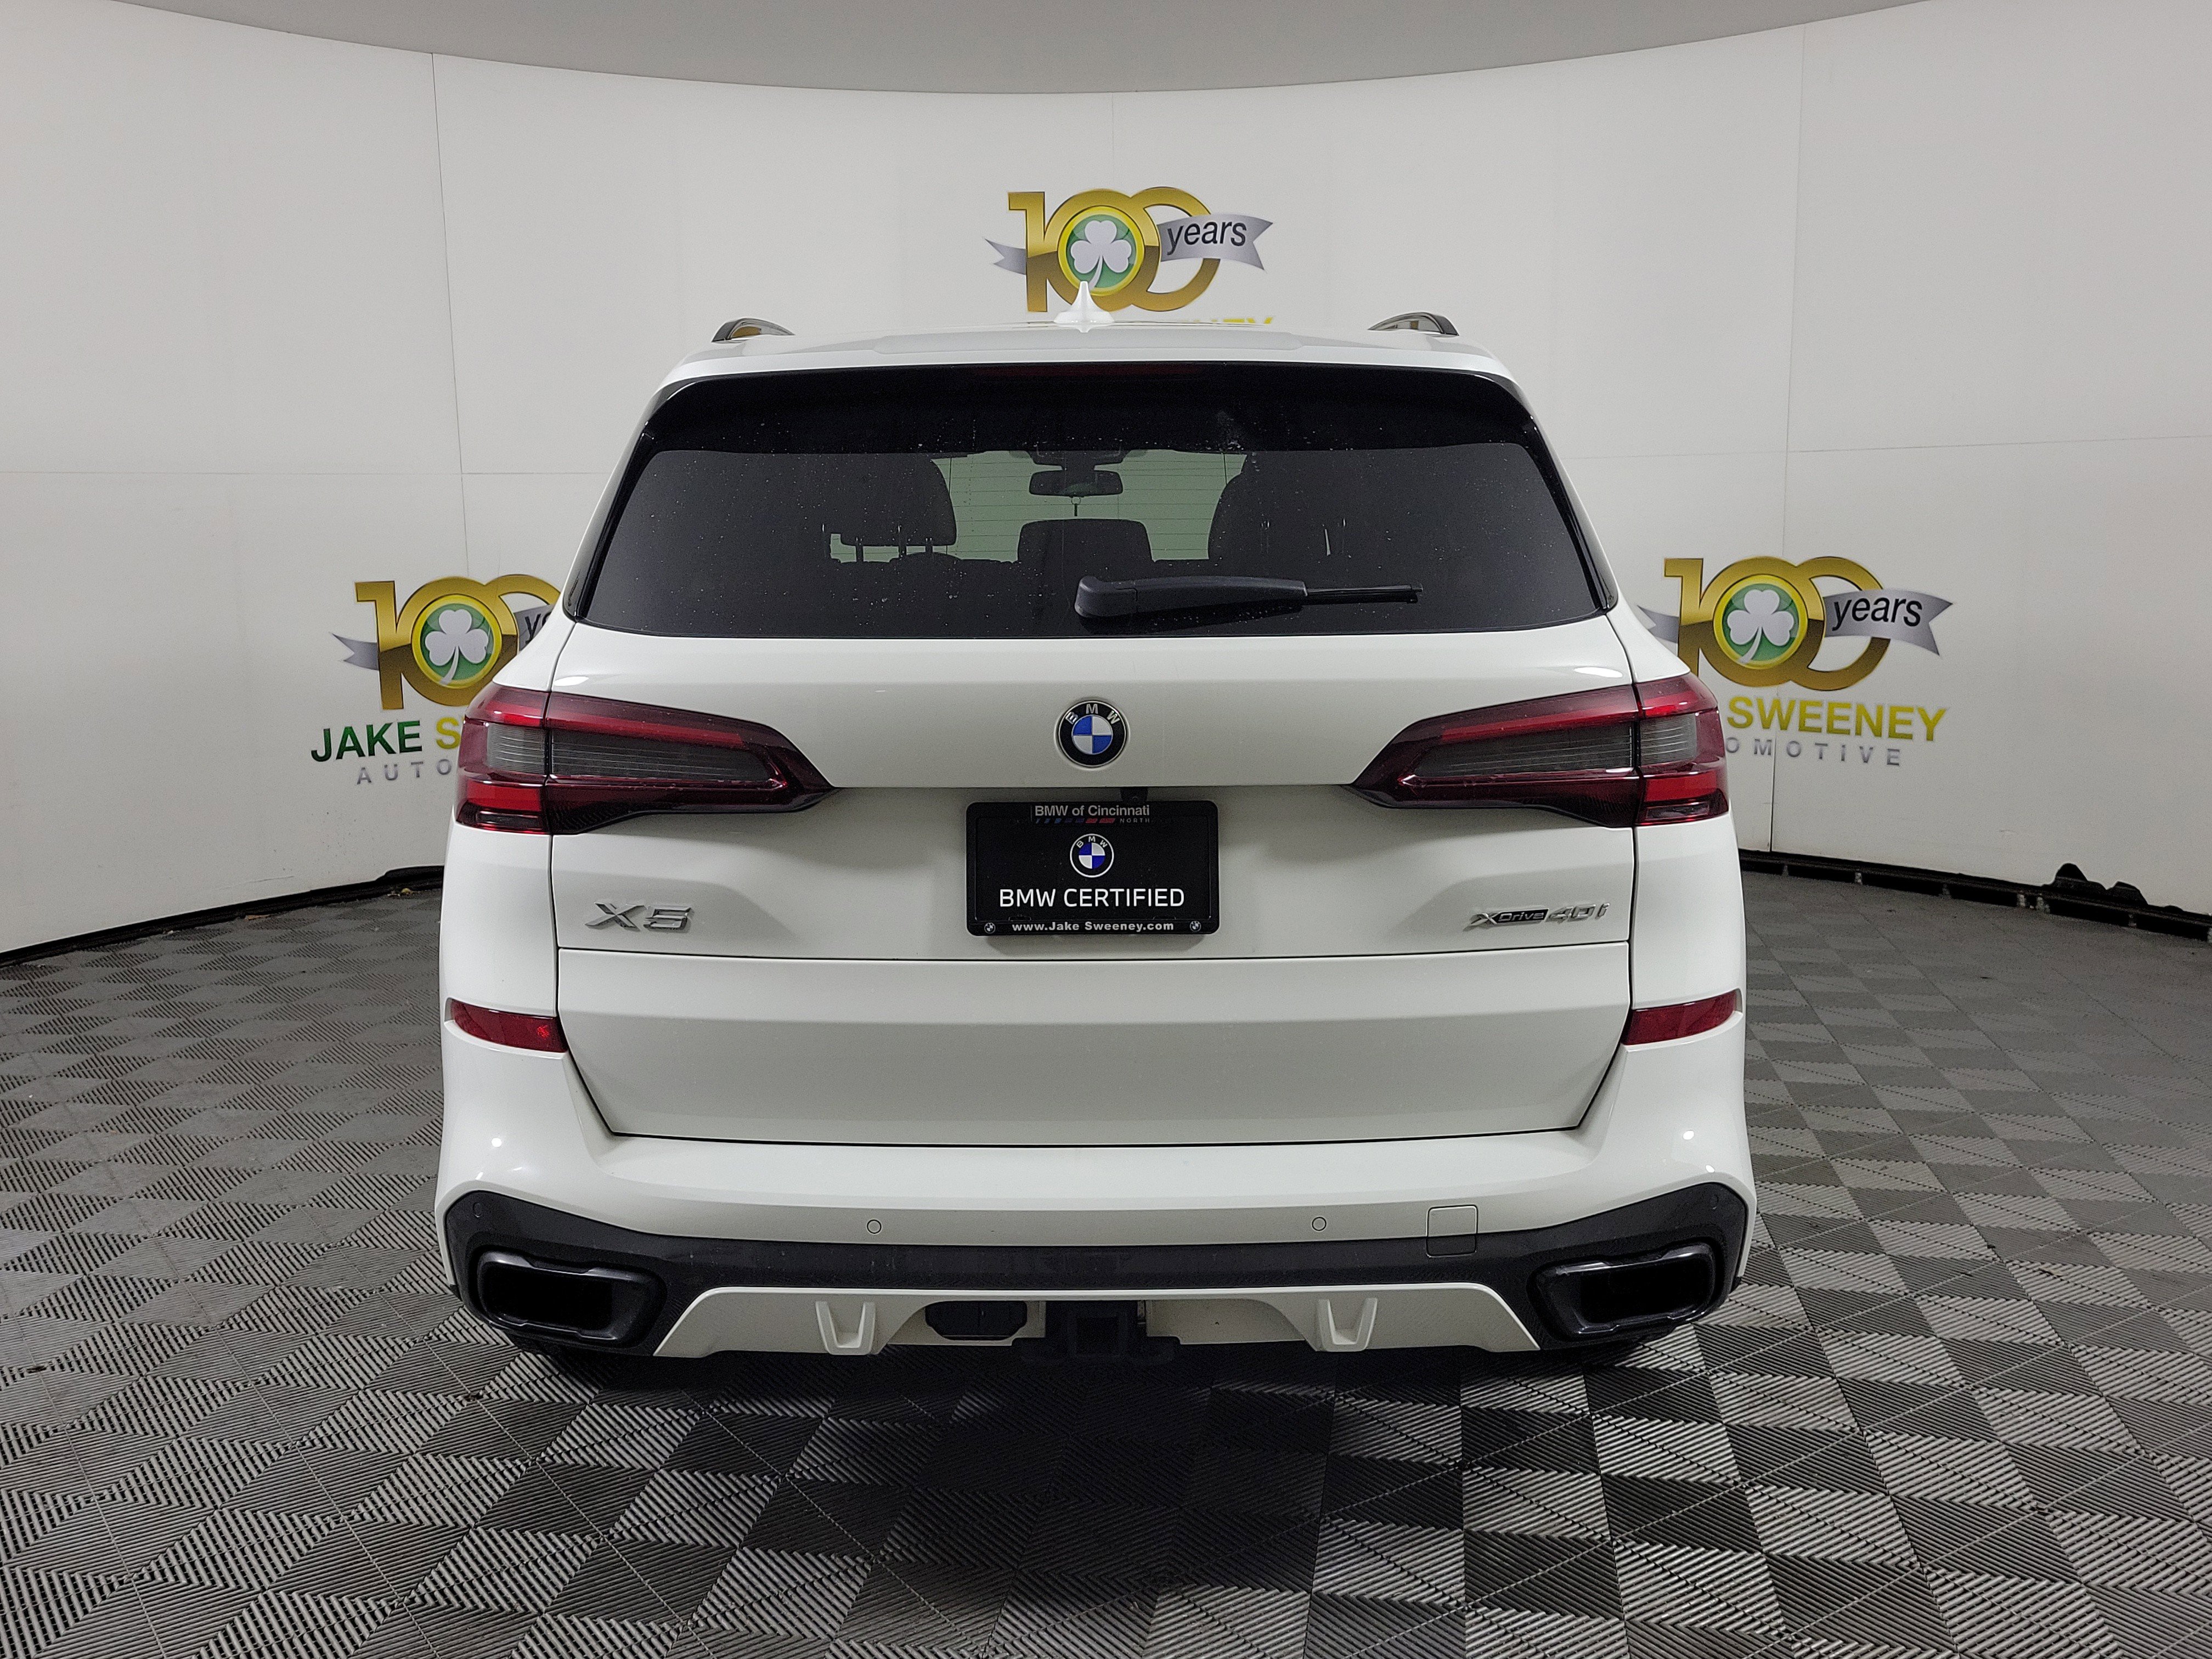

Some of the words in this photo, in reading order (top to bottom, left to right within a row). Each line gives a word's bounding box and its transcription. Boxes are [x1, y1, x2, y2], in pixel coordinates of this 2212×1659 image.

[1007, 187, 1221, 313] 100
[1166, 221, 1247, 256] years
[1664, 556, 1891, 691] 100
[1832, 596, 1922, 631] years
[1726, 696, 1947, 742] SWEENEY
[311, 720, 422, 762] JAKE
[1725, 737, 1901, 766] OMOTIVE
[356, 759, 452, 785] AUTO
[1035, 805, 1068, 816] BMW
[1071, 805, 1085, 816] of
[1088, 805, 1150, 816] Cincinnati
[1000, 889, 1056, 907] BMW
[1063, 888, 1185, 907] CERTIFIED
[584, 902, 692, 930] X5
